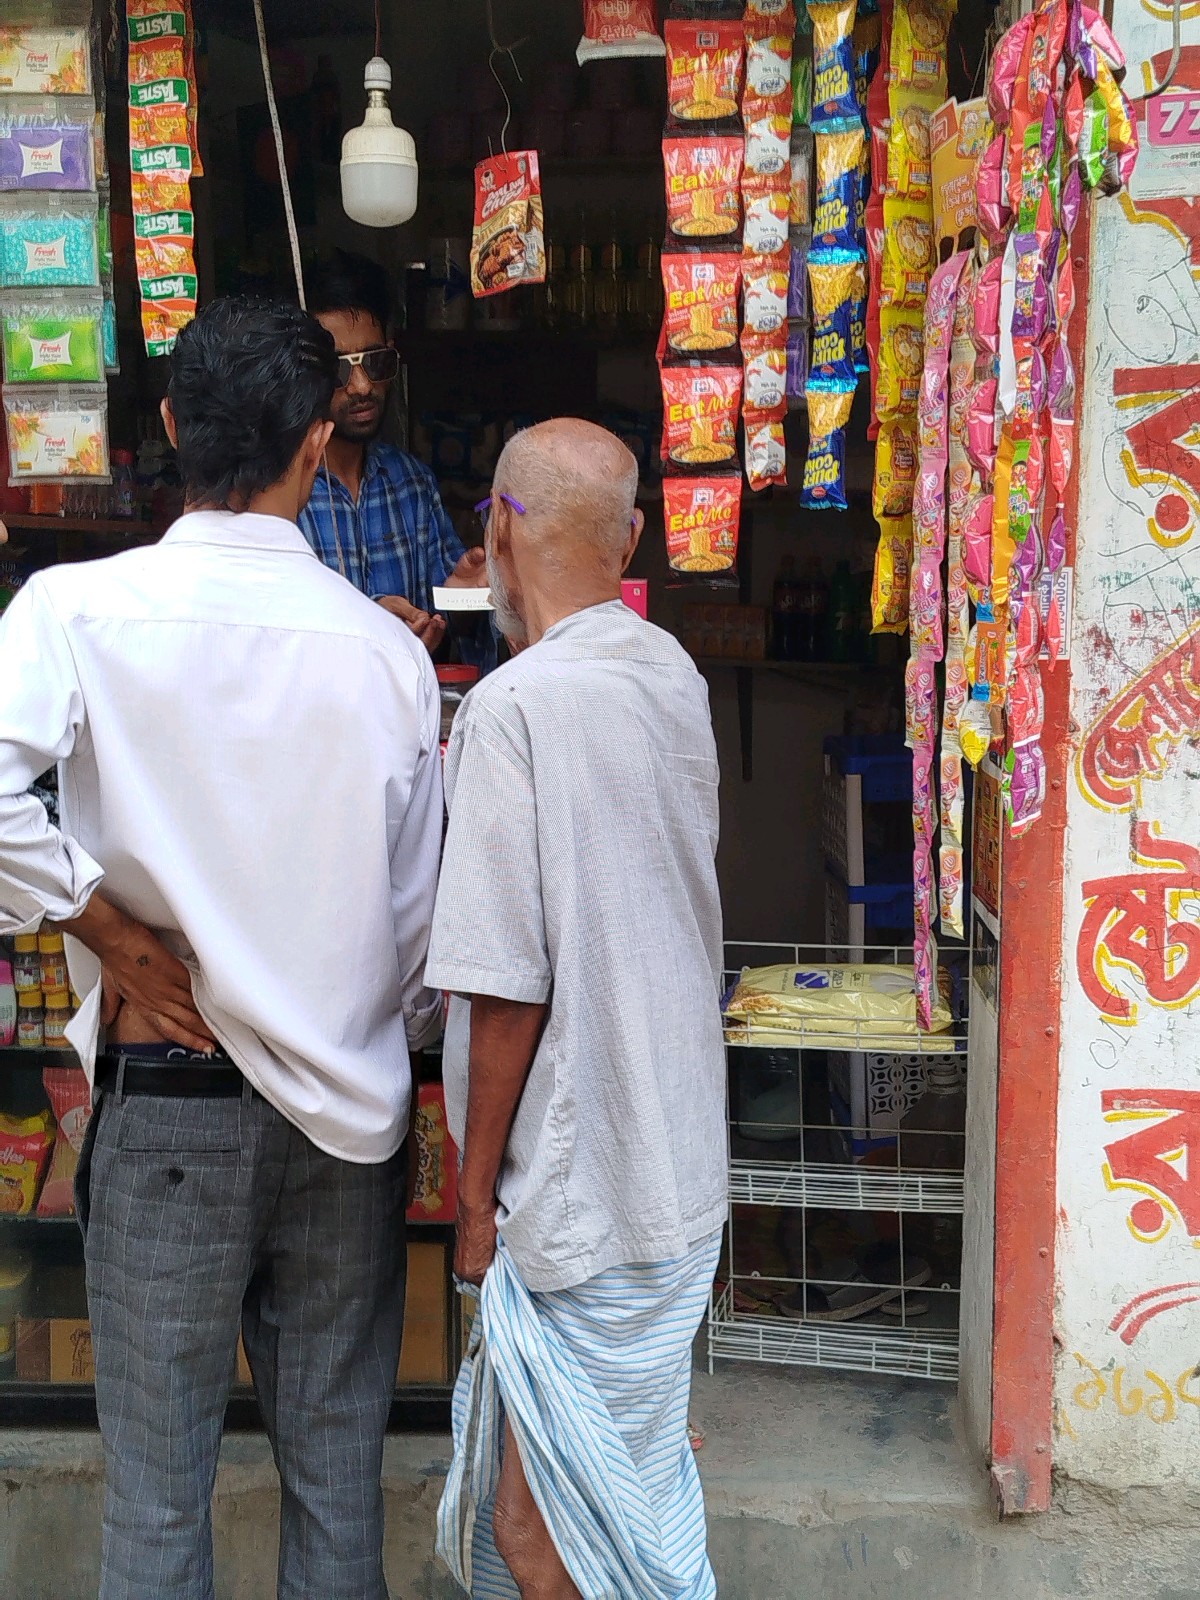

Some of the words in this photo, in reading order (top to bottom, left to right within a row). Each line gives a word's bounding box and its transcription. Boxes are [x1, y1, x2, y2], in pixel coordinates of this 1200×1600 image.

[136, 13, 177, 33] TASTE
[138, 80, 180, 104] TASTE
[140, 147, 182, 169] TASTE
[143, 214, 184, 235] TASTE
[149, 277, 188, 297] TASTE
[669, 284, 706, 309] Eat
[706, 281, 735, 300] Me
[39, 343, 62, 353] Fresh
[669, 399, 706, 422] Eat
[706, 395, 734, 414] Me
[669, 508, 704, 532] Eat
[703, 505, 733, 525] Me
